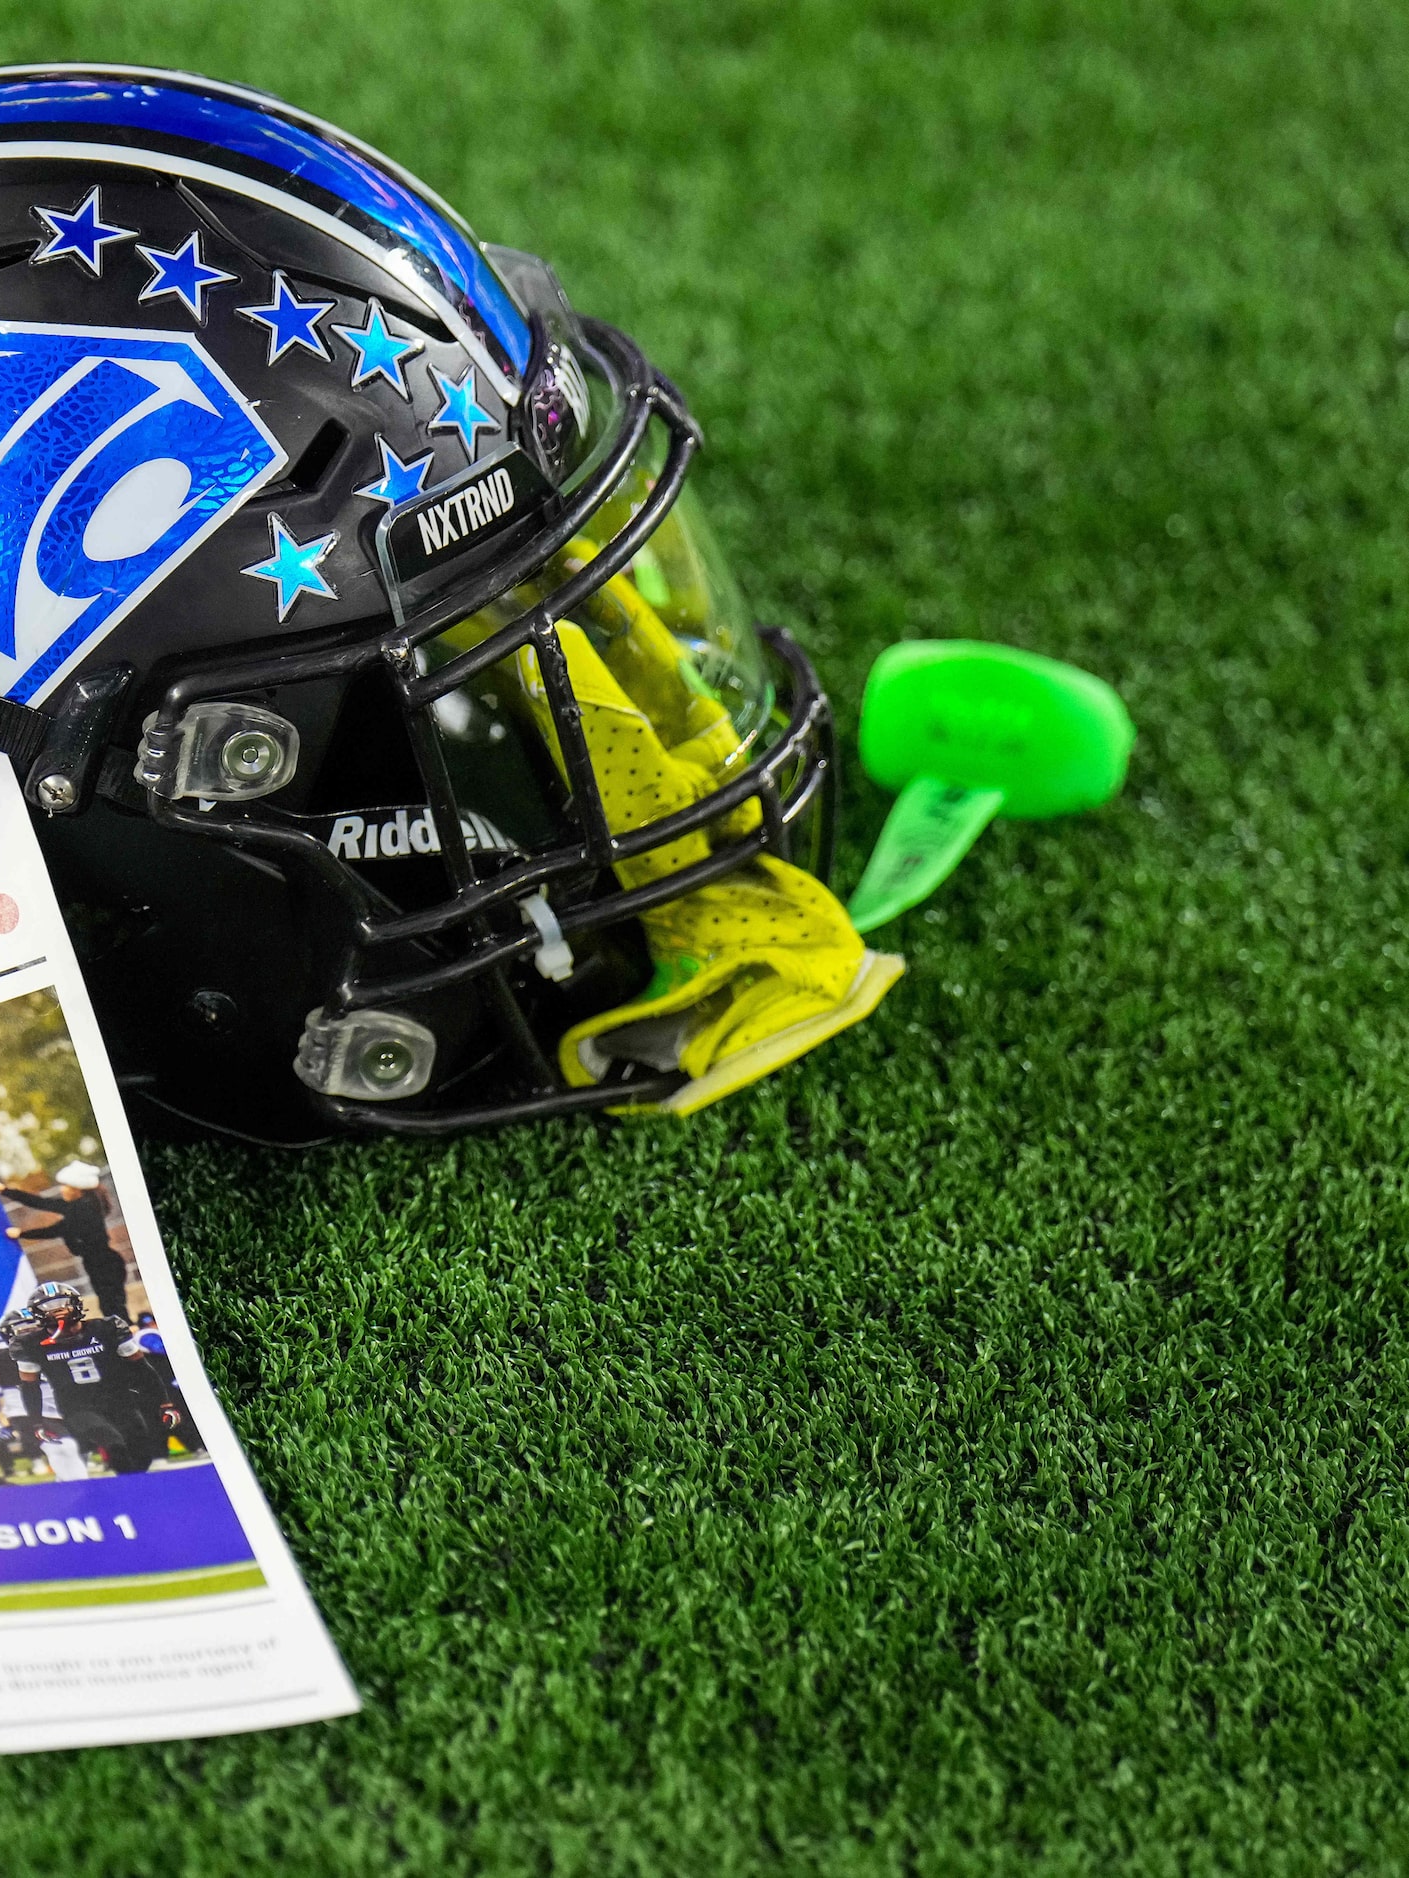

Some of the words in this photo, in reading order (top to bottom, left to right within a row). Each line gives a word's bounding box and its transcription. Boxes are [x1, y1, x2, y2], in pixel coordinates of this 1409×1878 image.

[416, 467, 515, 556] NXTRND
[46, 1351, 70, 1362] NORTH
[72, 1344, 104, 1358] CROWLEY
[67, 1356, 102, 1385] 8
[112, 1513, 138, 1540] 1
